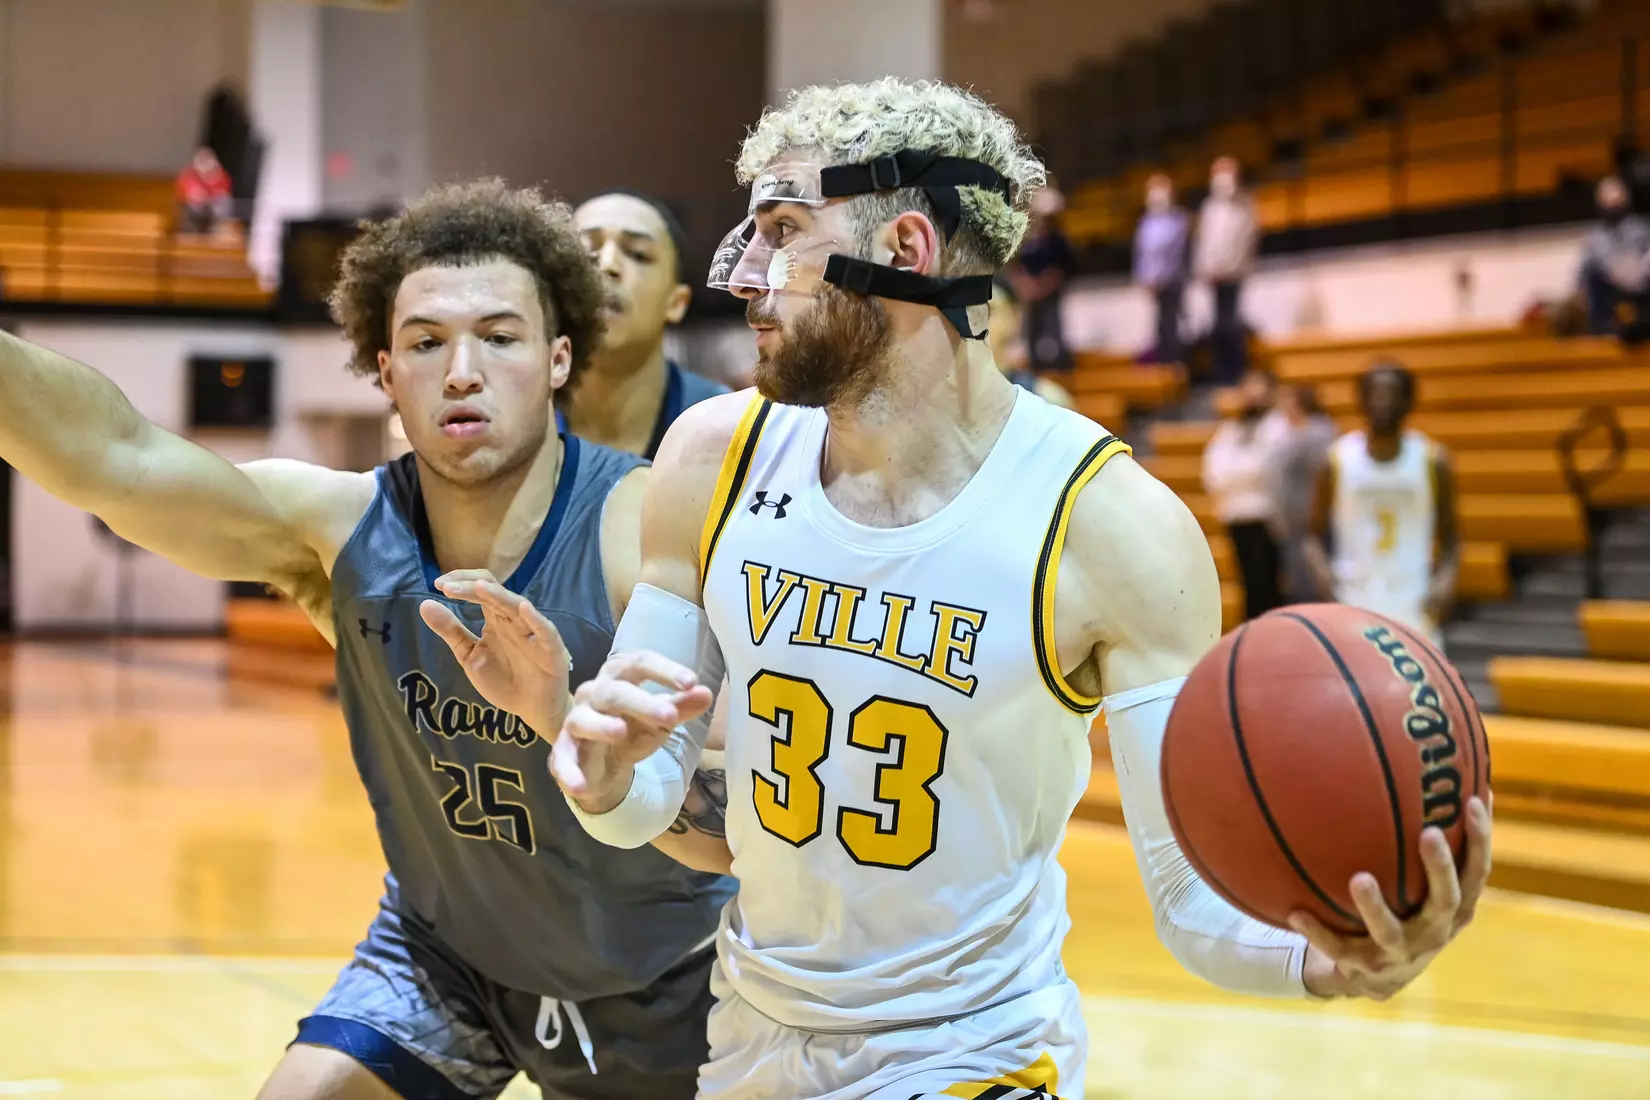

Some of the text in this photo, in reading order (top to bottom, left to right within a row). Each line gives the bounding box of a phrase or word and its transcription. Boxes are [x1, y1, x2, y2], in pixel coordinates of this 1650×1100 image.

[741, 560, 987, 698] VILLE
[397, 670, 538, 748] Rams
[747, 668, 949, 871] 33
[1364, 625, 1462, 829] Wilson
[430, 753, 536, 856] 25
